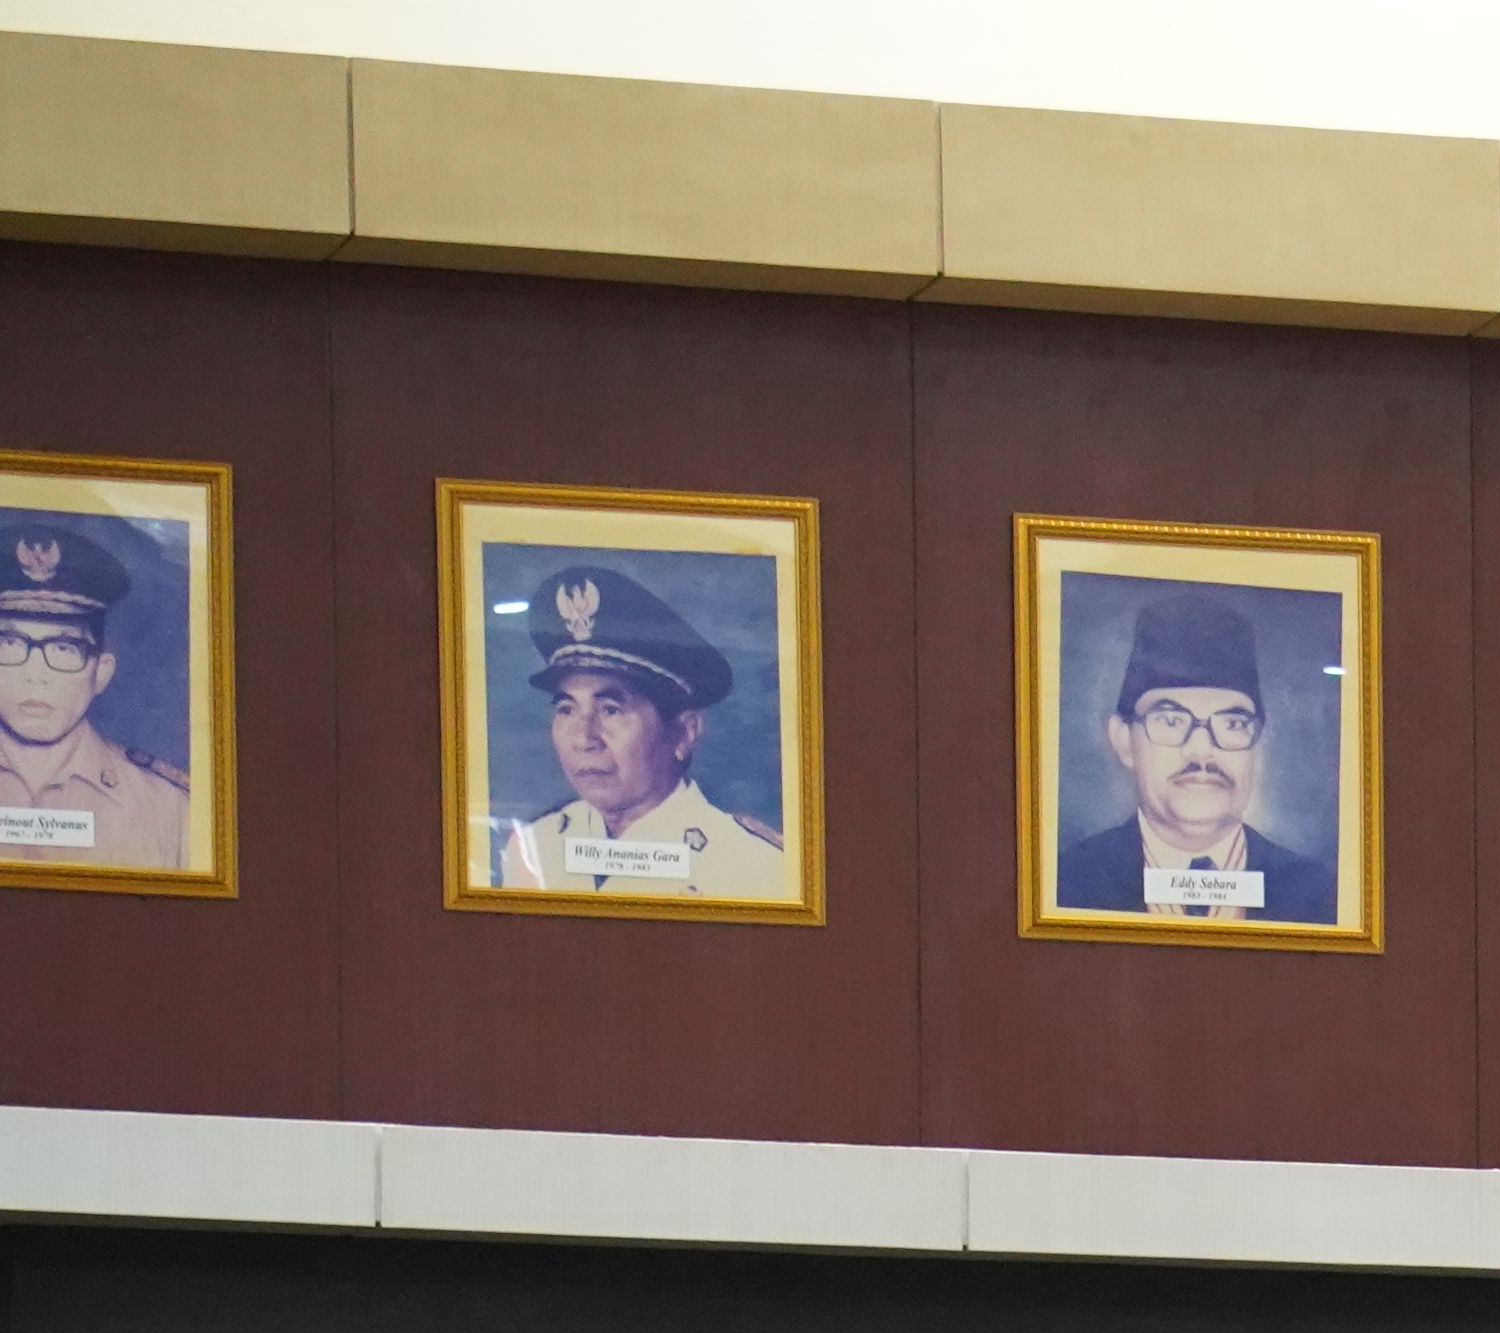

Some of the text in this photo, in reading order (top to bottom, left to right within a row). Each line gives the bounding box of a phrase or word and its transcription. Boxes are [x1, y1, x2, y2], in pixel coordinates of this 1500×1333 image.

[574, 844, 680, 864] Willy Ananias Gara
[1170, 876, 1237, 891] Eddy Sabara
